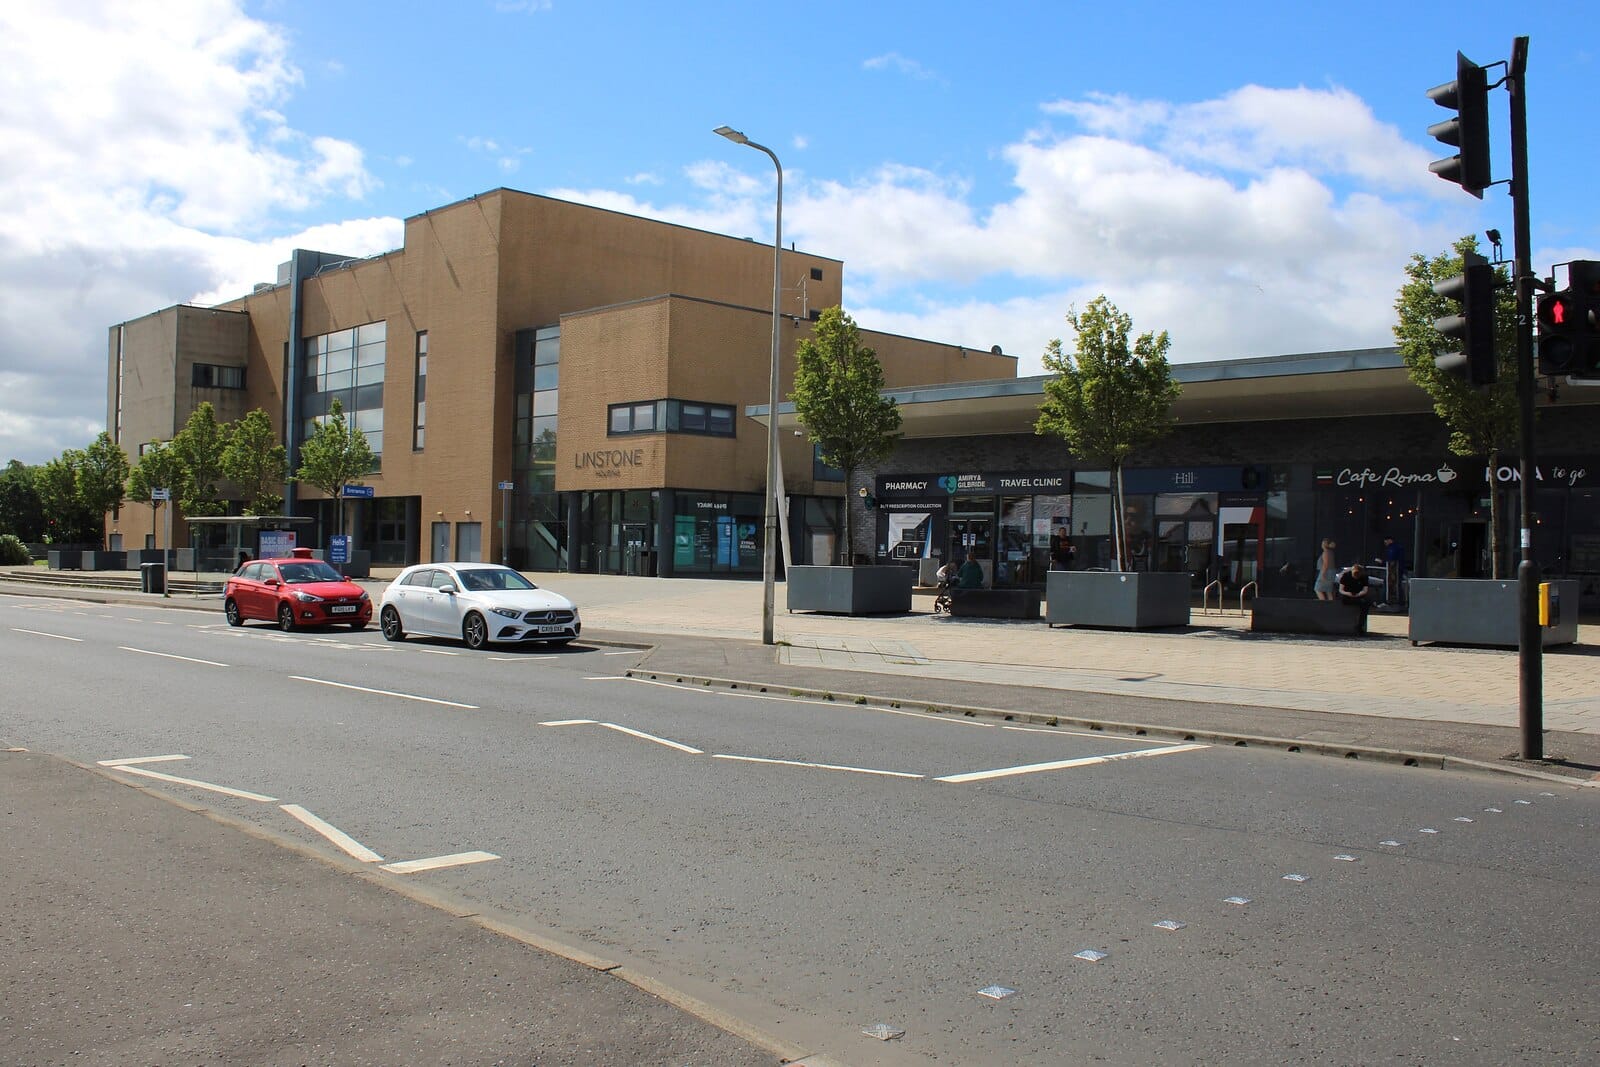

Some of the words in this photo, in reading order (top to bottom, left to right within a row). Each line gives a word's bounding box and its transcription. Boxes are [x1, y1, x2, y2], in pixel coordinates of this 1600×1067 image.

[1519, 315, 1526, 325] 2
[575, 449, 643, 468] LINSTONE
[1000, 478, 1031, 487] TRAVEL
[1033, 477, 1062, 487] CLINIC
[1175, 472, 1194, 484] Hill
[1337, 468, 1381, 488] Cafe
[1382, 467, 1436, 487] Roma
[1552, 466, 1566, 478] to
[1570, 468, 1585, 486] go
[885, 481, 928, 491] PHARMACY
